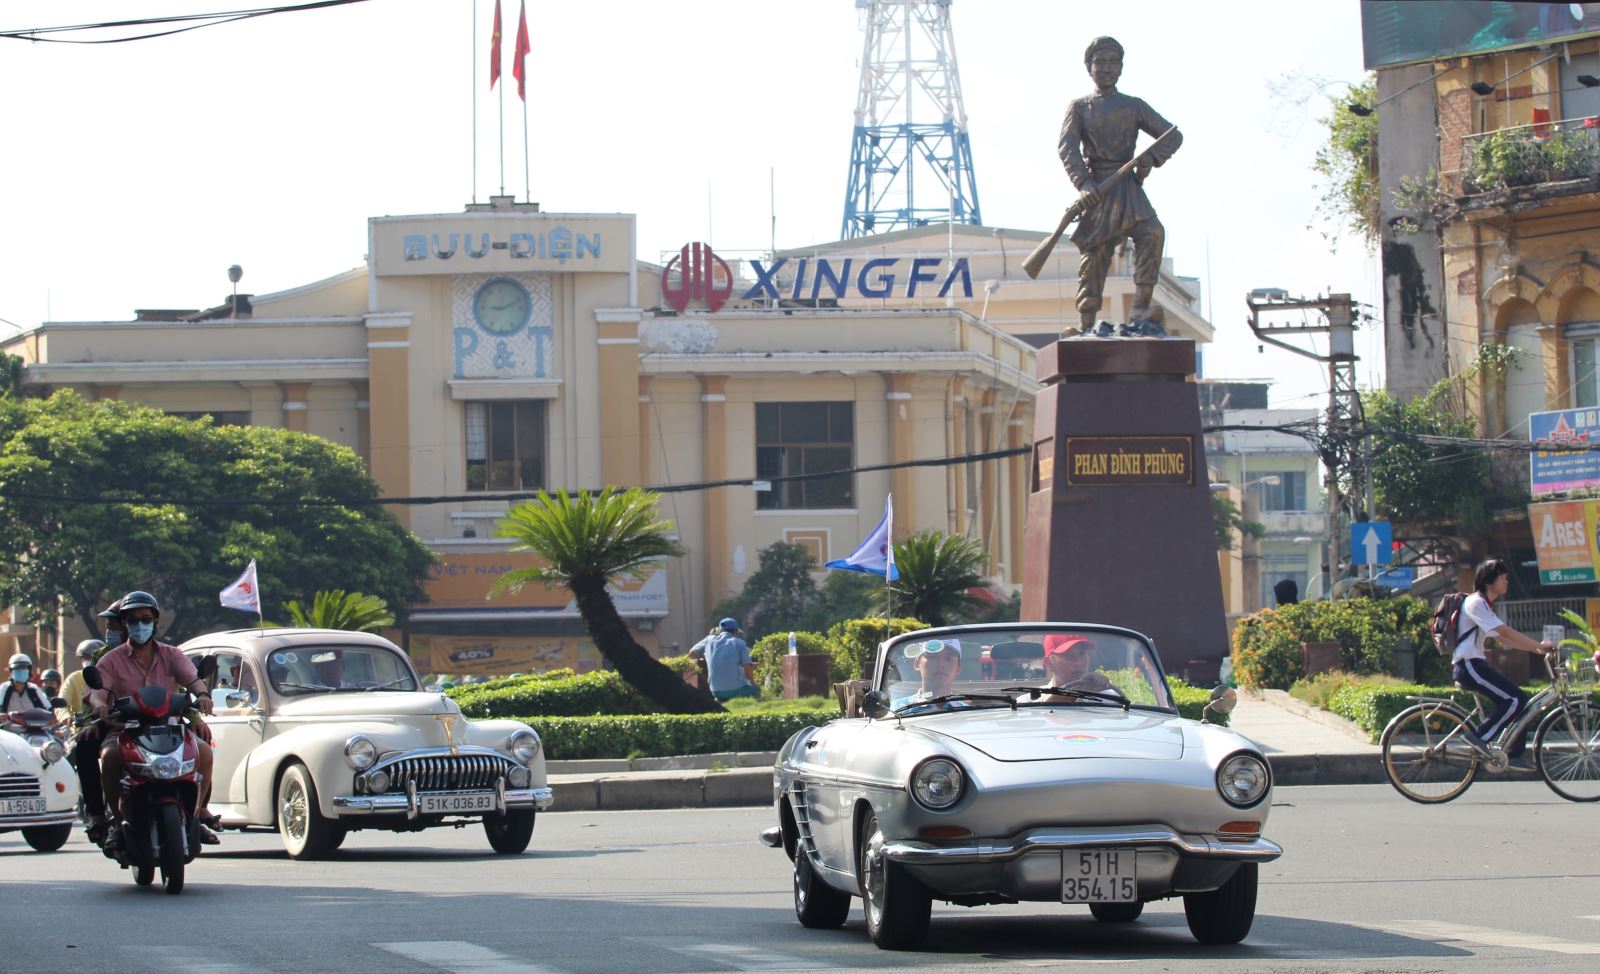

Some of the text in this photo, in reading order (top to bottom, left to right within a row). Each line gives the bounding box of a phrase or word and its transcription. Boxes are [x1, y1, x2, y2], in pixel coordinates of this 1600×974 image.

[742, 257, 974, 299] XINGFA
[1074, 453, 1108, 475] PHAN
[1111, 447, 1141, 475] ĐÌNH
[1144, 447, 1185, 475] PHÙNG
[1540, 514, 1586, 547] ARES
[1079, 852, 1119, 875] 51H
[1064, 877, 1134, 900] 354.15
